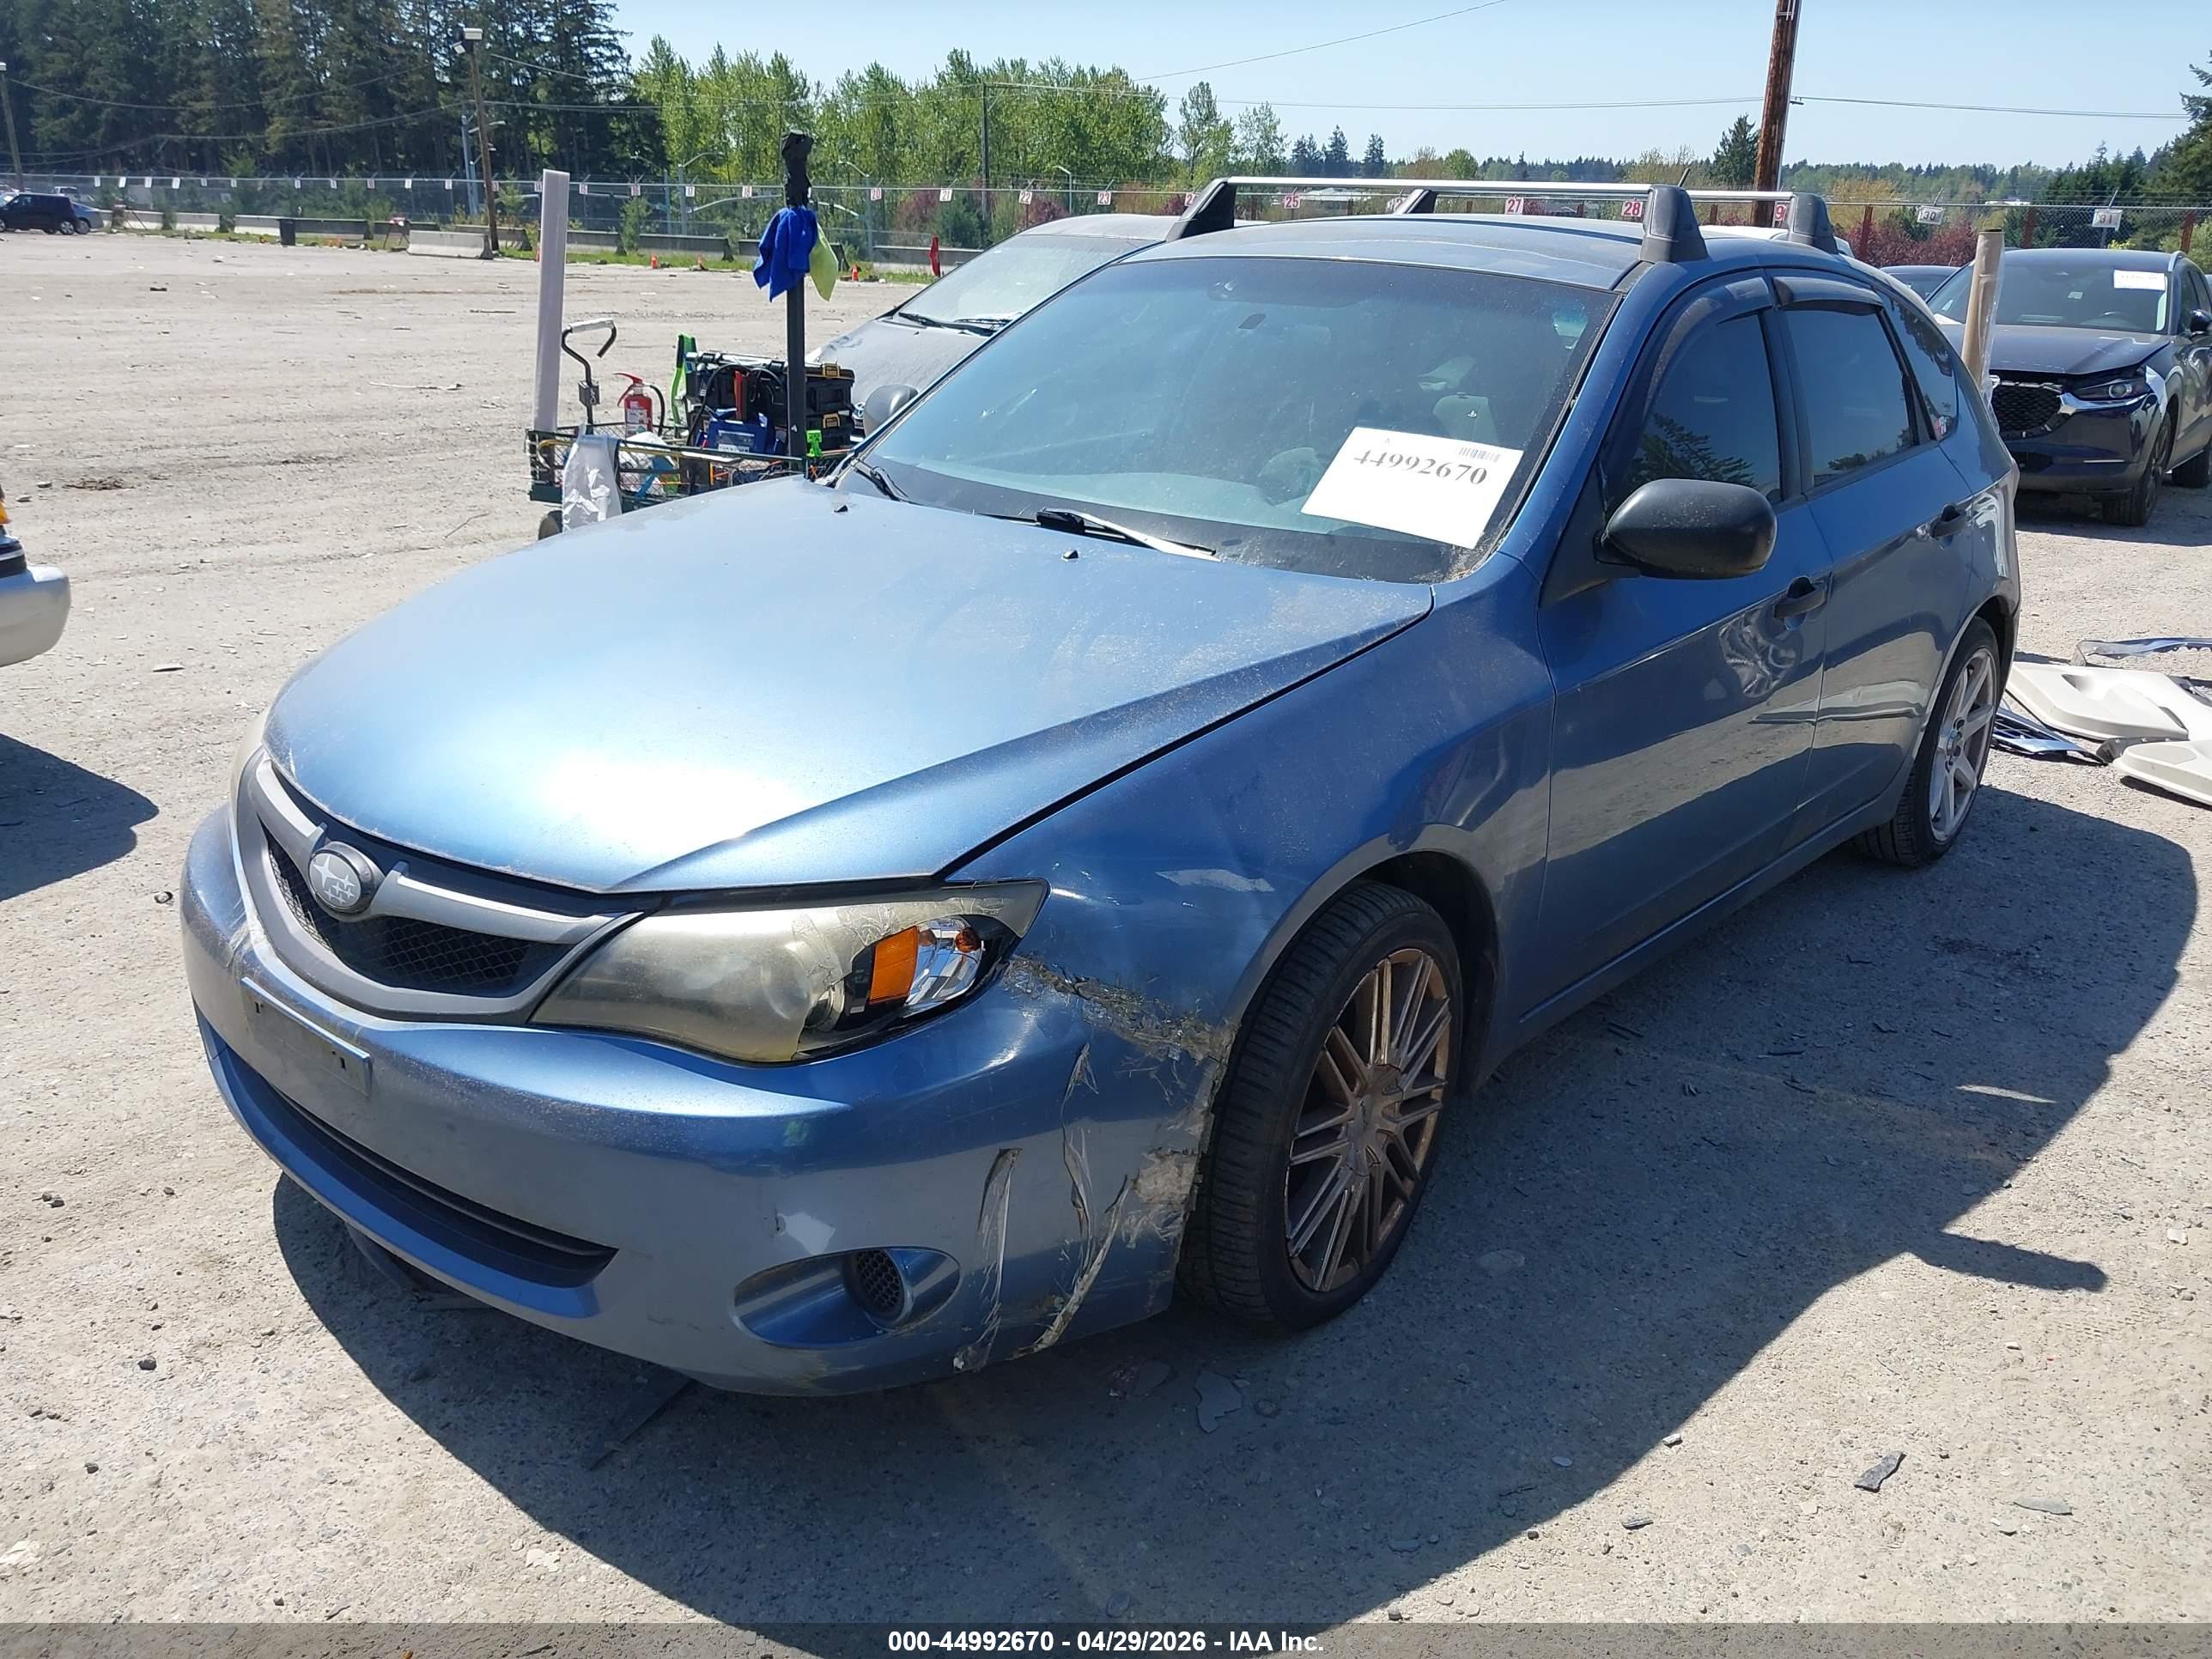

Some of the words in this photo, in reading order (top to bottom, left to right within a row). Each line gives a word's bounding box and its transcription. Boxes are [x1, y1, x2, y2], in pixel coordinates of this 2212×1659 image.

[871, 189, 880, 199] 20
[941, 190, 951, 200] 21
[1020, 191, 1030, 203] 22
[1099, 192, 1109, 204] 23
[1285, 196, 1298, 208] 25
[1507, 198, 1522, 213] 27
[1623, 202, 1641, 216] 28
[1776, 205, 1784, 220] 9
[1923, 210, 1936, 221] 30
[2100, 214, 2112, 224] 31
[1354, 449, 1487, 485] 44992670
